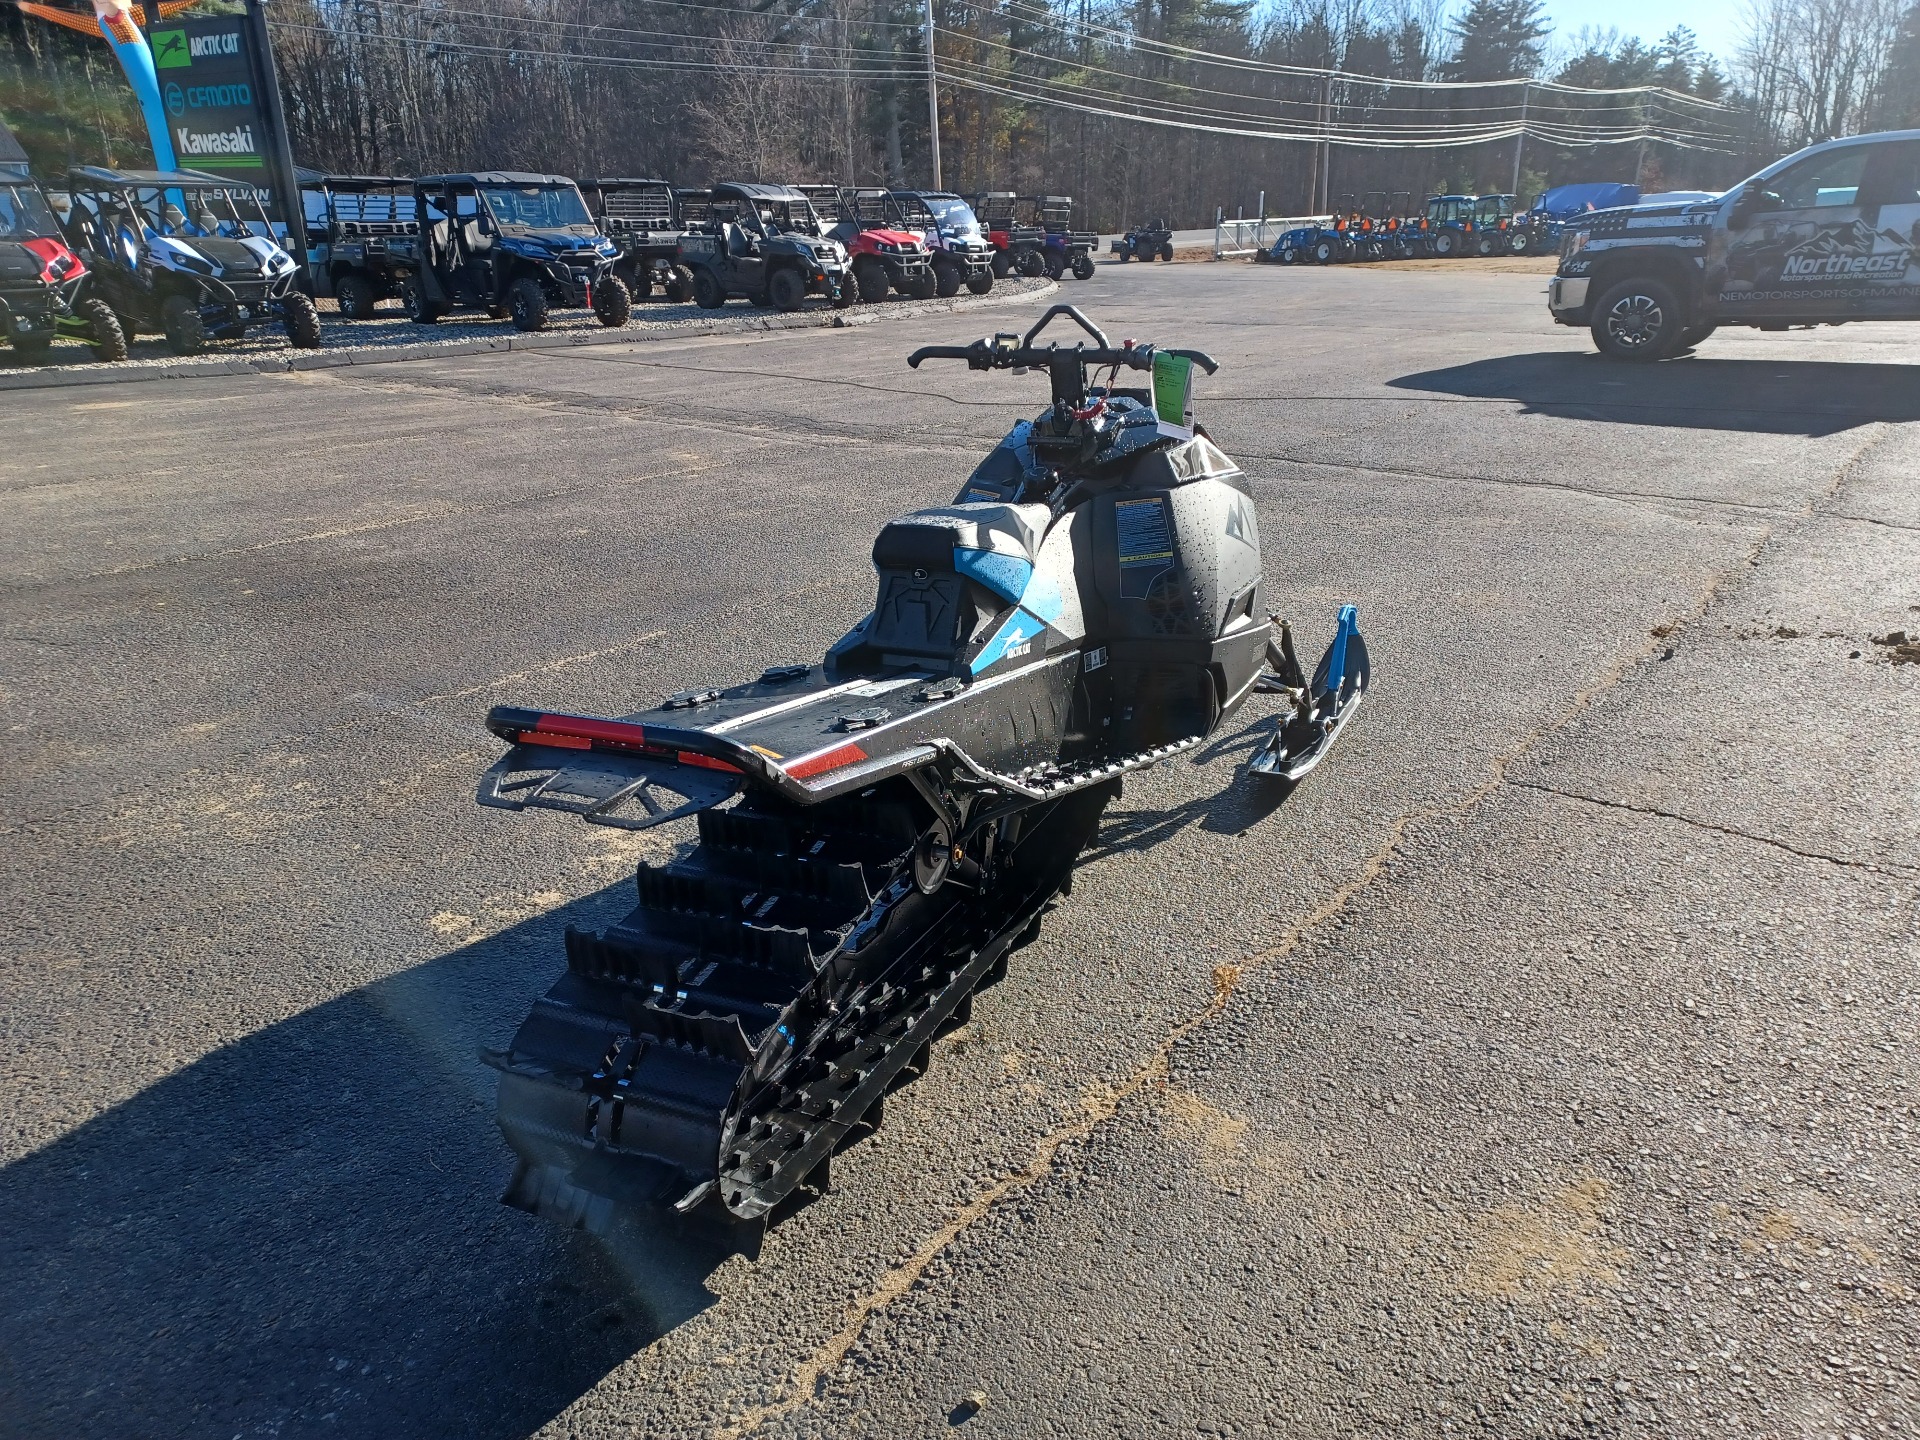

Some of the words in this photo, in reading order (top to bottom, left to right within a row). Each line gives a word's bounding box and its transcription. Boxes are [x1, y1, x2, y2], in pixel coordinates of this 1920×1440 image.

[190, 35, 221, 56] ARCTIC
[221, 33, 239, 53] CAT
[187, 84, 251, 107] CFMOTO
[177, 125, 255, 153] Kawasaki
[1783, 251, 1910, 275] Northeast
[1779, 272, 1833, 282] Motorsports
[1834, 272, 1852, 280] and
[1853, 271, 1904, 279] Recreation
